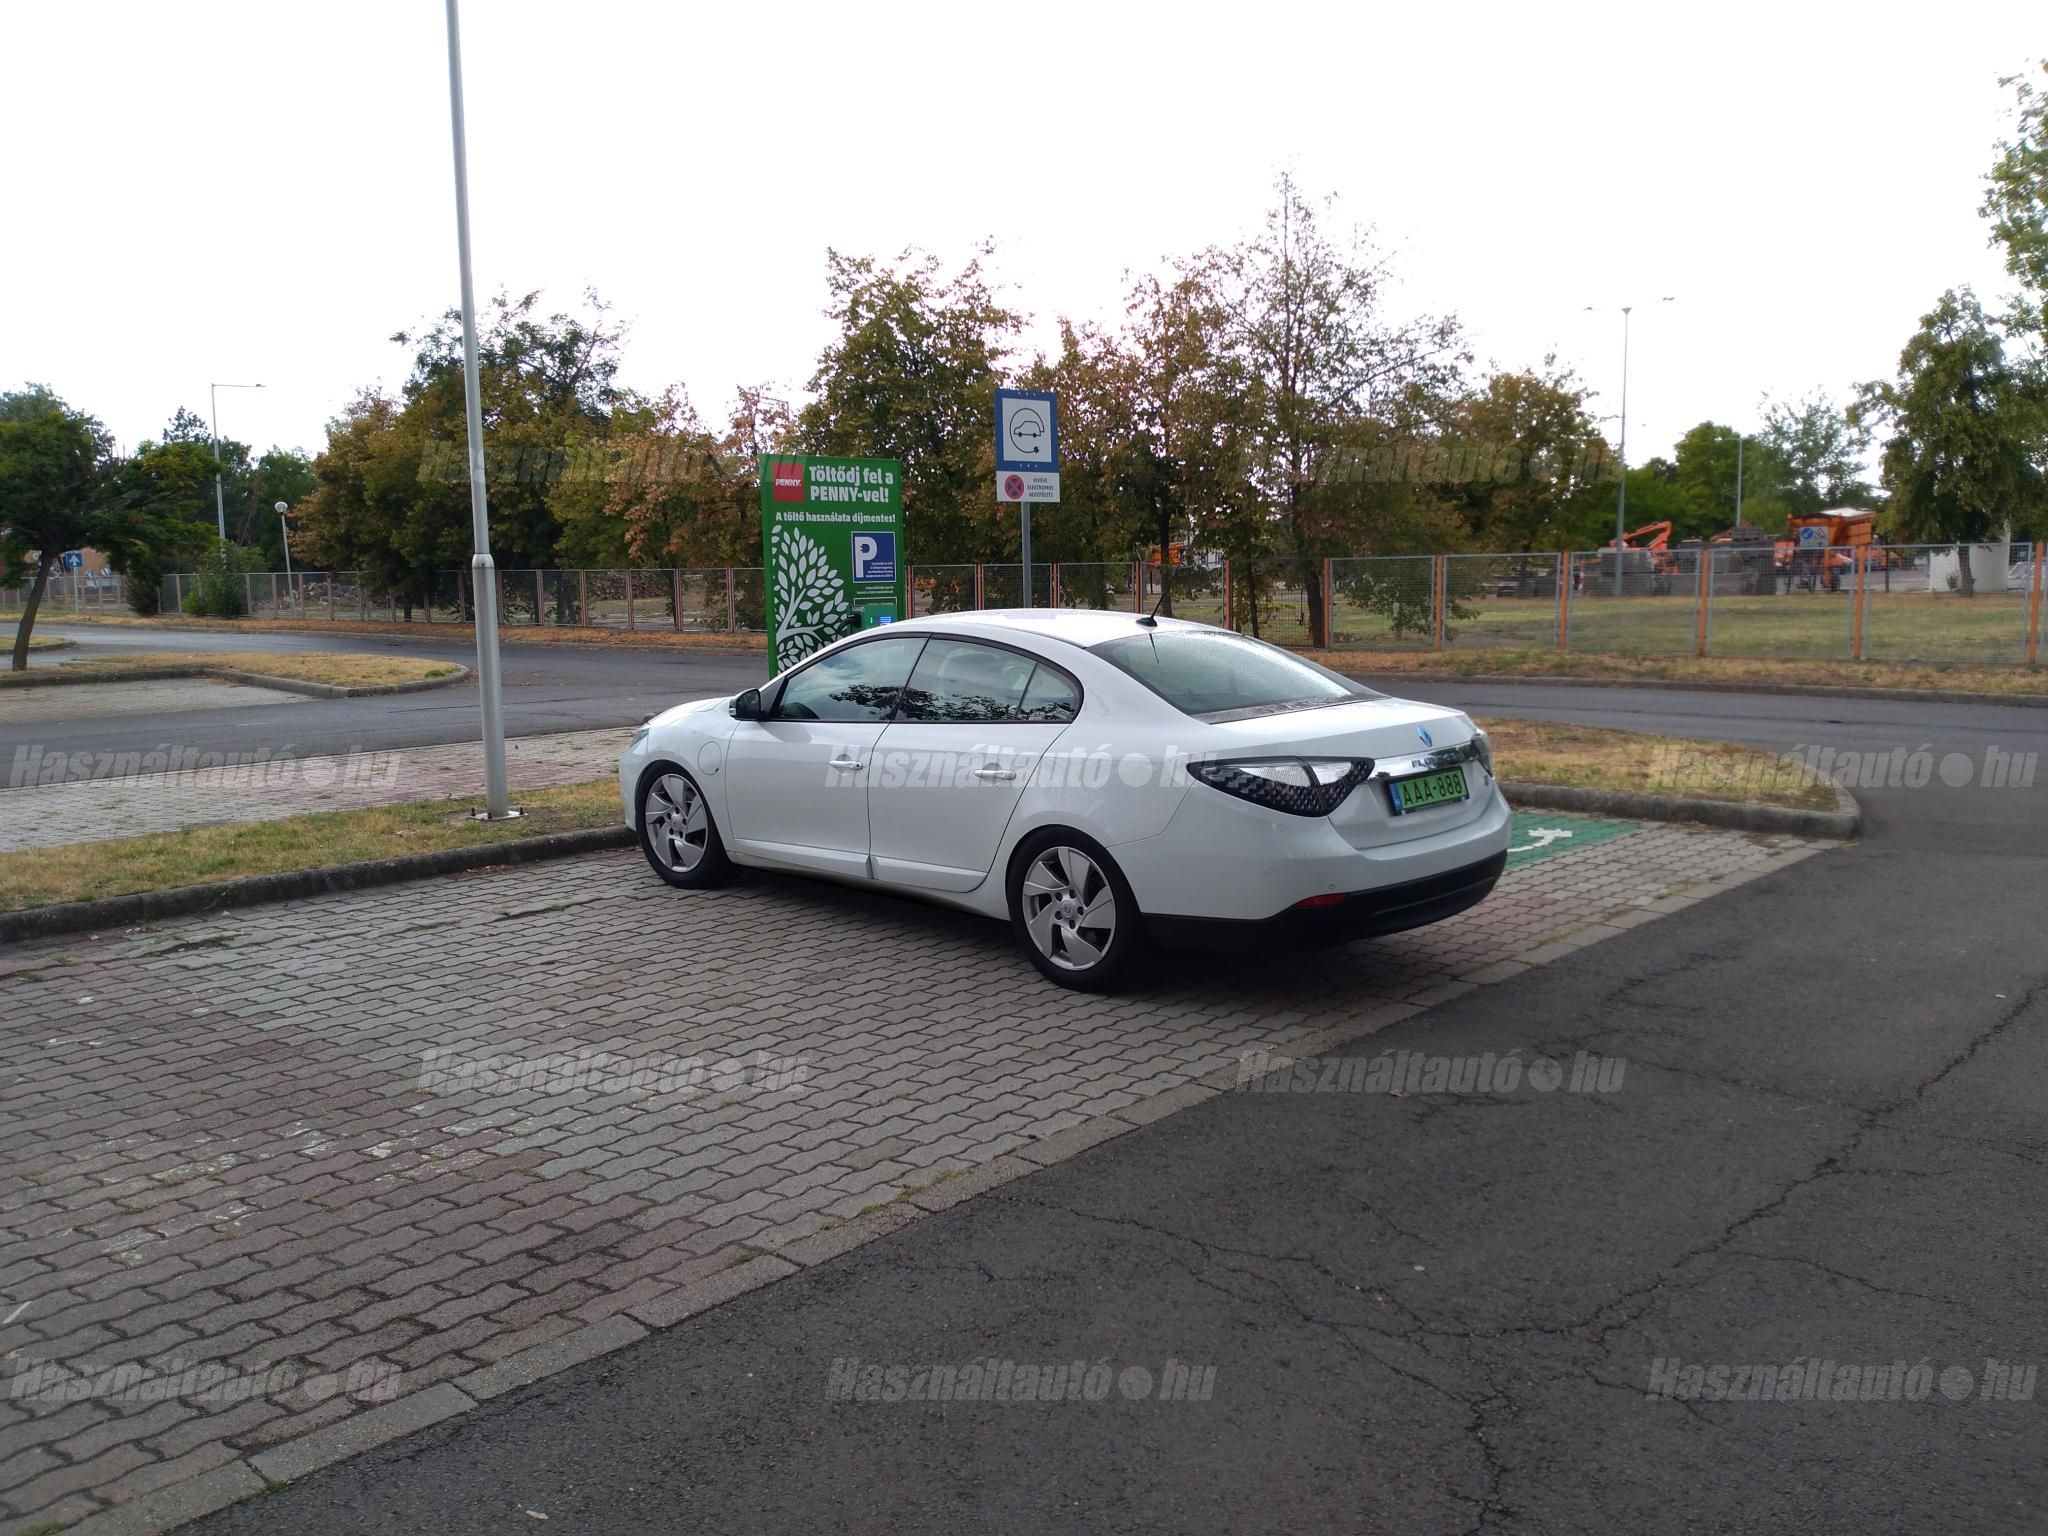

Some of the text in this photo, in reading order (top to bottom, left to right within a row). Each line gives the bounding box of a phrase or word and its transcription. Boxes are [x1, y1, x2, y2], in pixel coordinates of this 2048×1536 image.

[809, 466, 894, 486] Töltődj fel a
[810, 485, 889, 503] PENNY-vel!
[775, 512, 783, 521] A
[783, 512, 805, 522] töltő
[806, 512, 851, 523] használata
[1403, 774, 1462, 805] AAA-888
